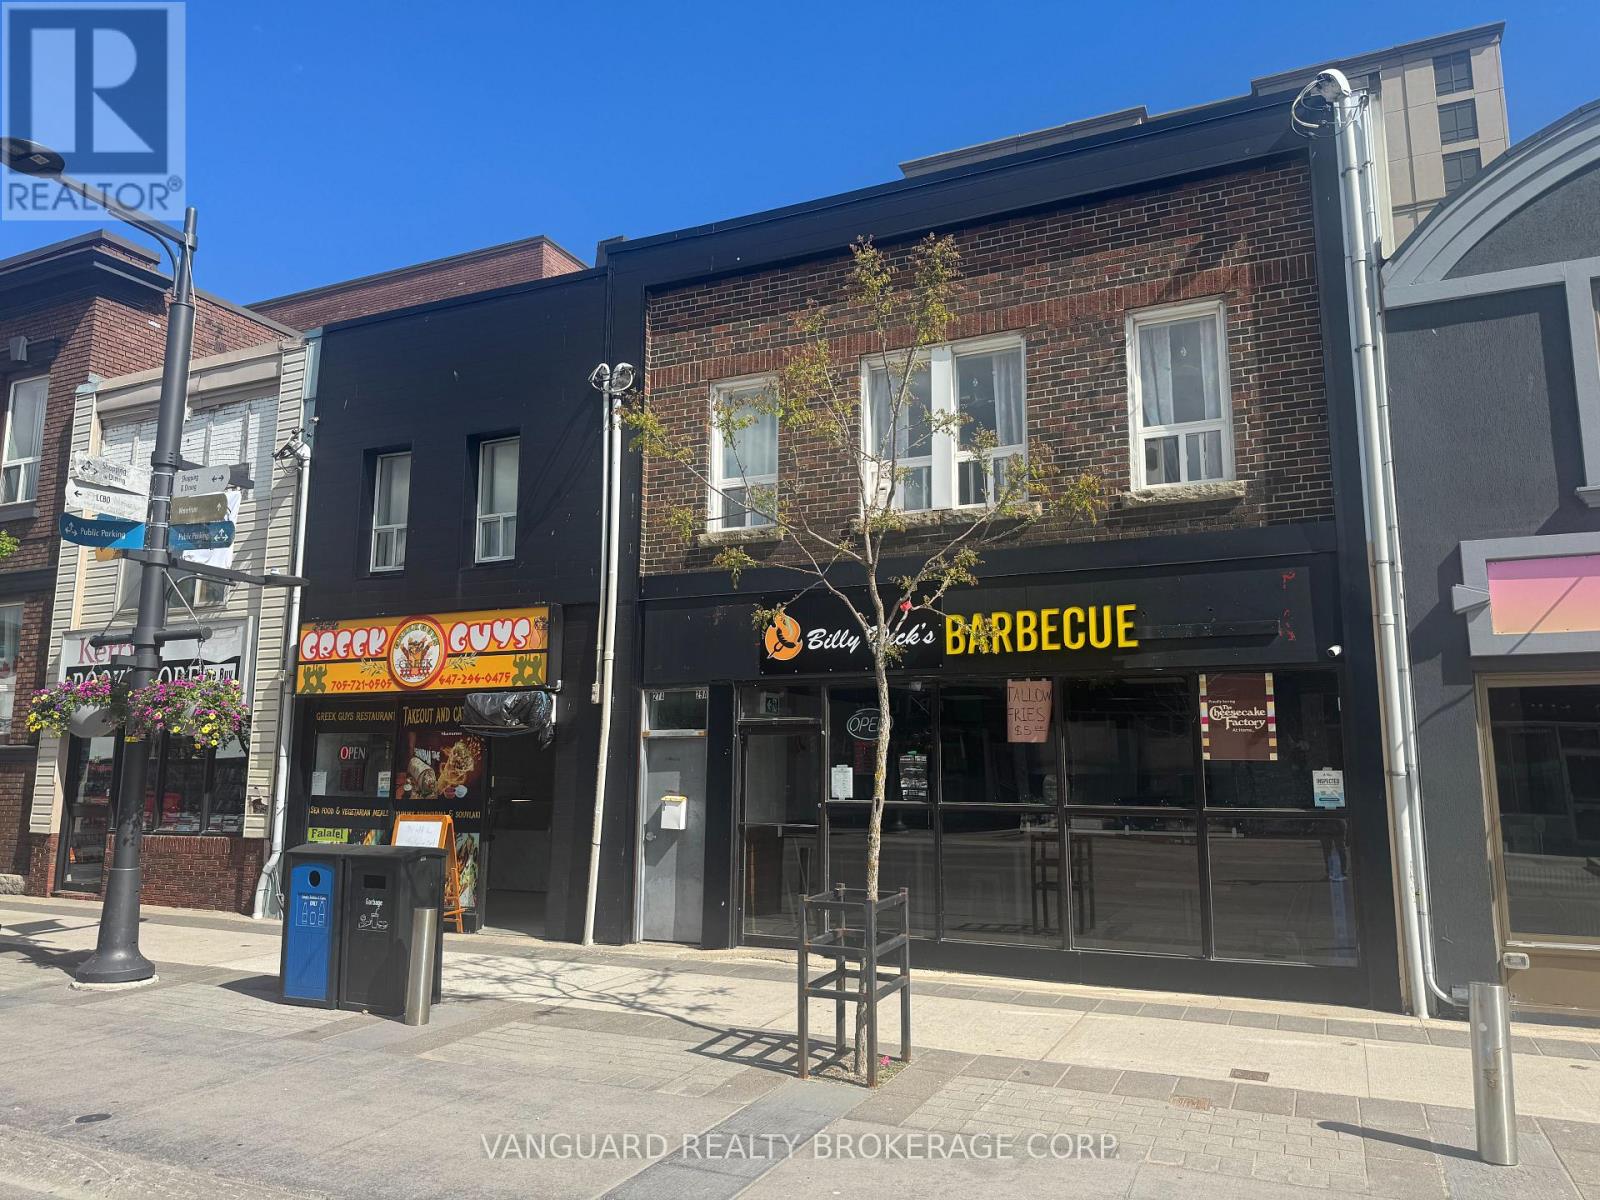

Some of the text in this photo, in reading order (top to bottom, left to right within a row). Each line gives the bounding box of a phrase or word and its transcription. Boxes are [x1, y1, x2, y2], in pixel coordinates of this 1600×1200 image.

[102, 461, 127, 477] Shopping
[96, 494, 111, 504] LCBO
[80, 527, 126, 540] Public Parking
[806, 627, 862, 654] Billy
[945, 604, 1140, 656] BARBECUE
[301, 617, 531, 661] GREEK GUYS
[316, 711, 396, 721] GREEK GUYS RESTAURANT
[403, 705, 433, 727] TAKEOUT
[435, 706, 451, 725] AND
[1209, 705, 1267, 721] Cheesecake
[849, 716, 882, 733] OPE
[1224, 716, 1266, 730] Factory
[340, 745, 367, 760] OPEN
[312, 828, 344, 839] Falafel
